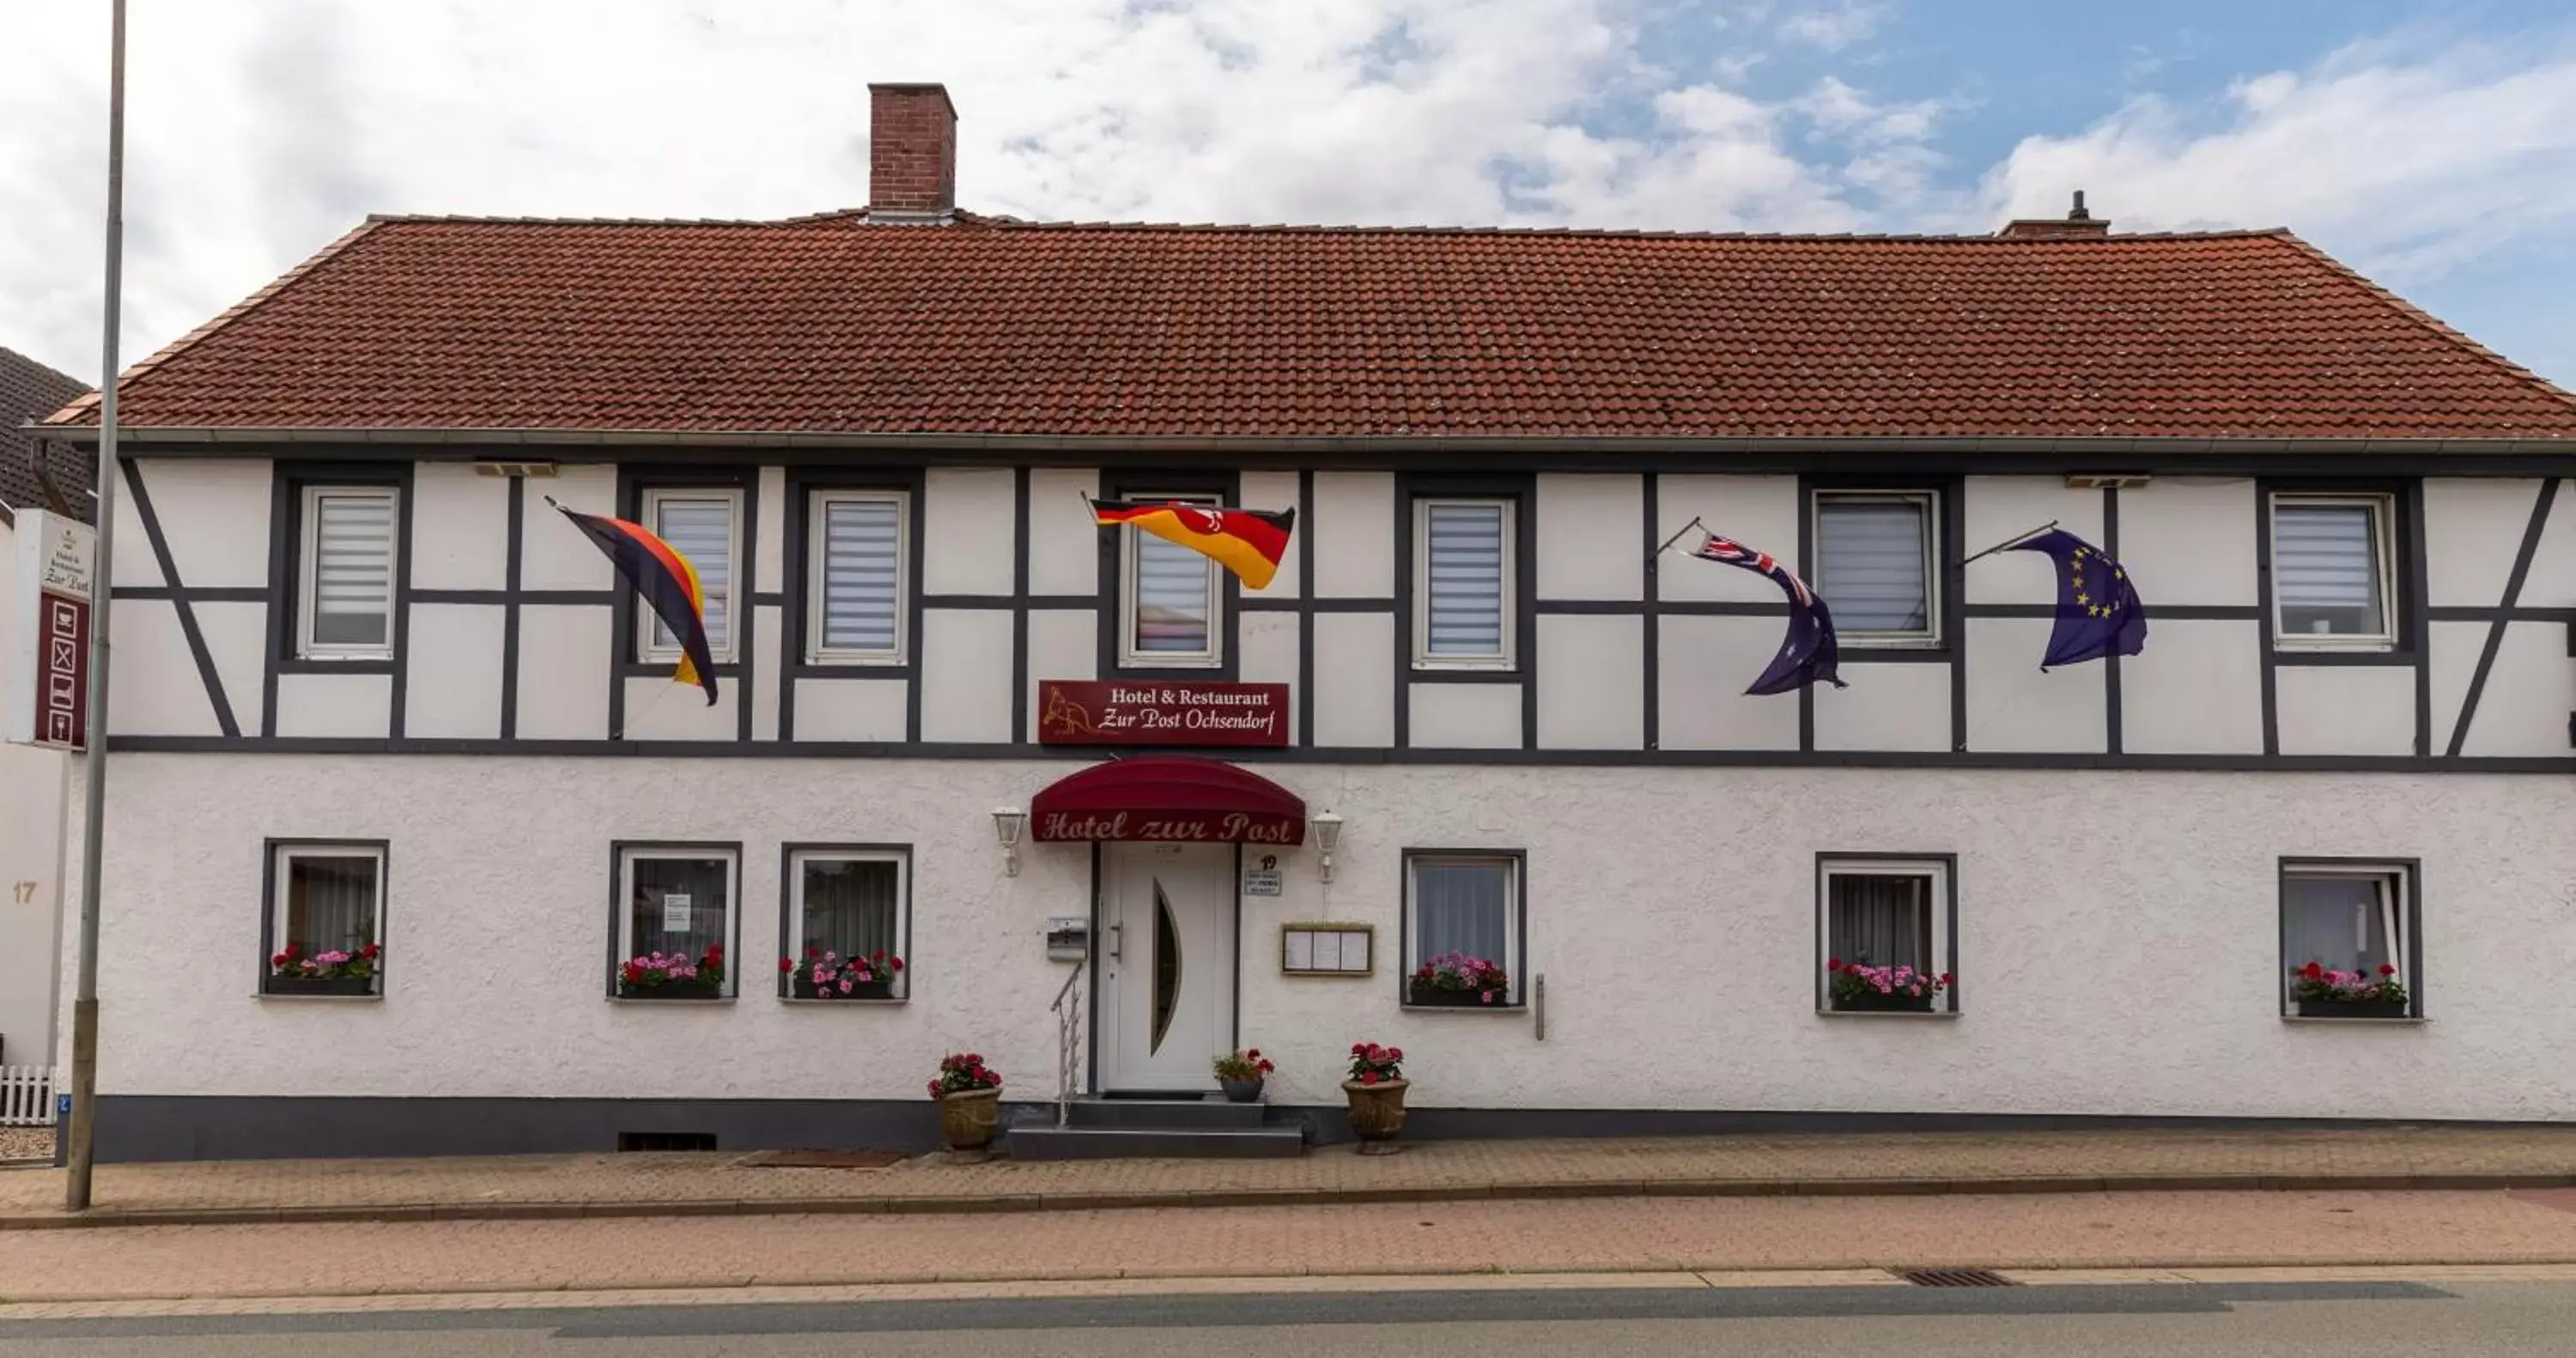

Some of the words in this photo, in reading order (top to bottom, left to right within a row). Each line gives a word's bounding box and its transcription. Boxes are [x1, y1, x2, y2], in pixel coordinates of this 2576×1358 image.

[45, 567, 65, 585] Zur
[1111, 688, 1157, 705] Hotel
[1161, 689, 1175, 704] &
[1180, 689, 1269, 706] Restaurant
[1097, 708, 1135, 729] Zur
[1139, 708, 1181, 730] Post
[1186, 708, 1275, 736] Ochsendorf
[1042, 811, 1127, 840] Hotel
[1139, 821, 1208, 840] zur
[13, 881, 38, 904] 17
